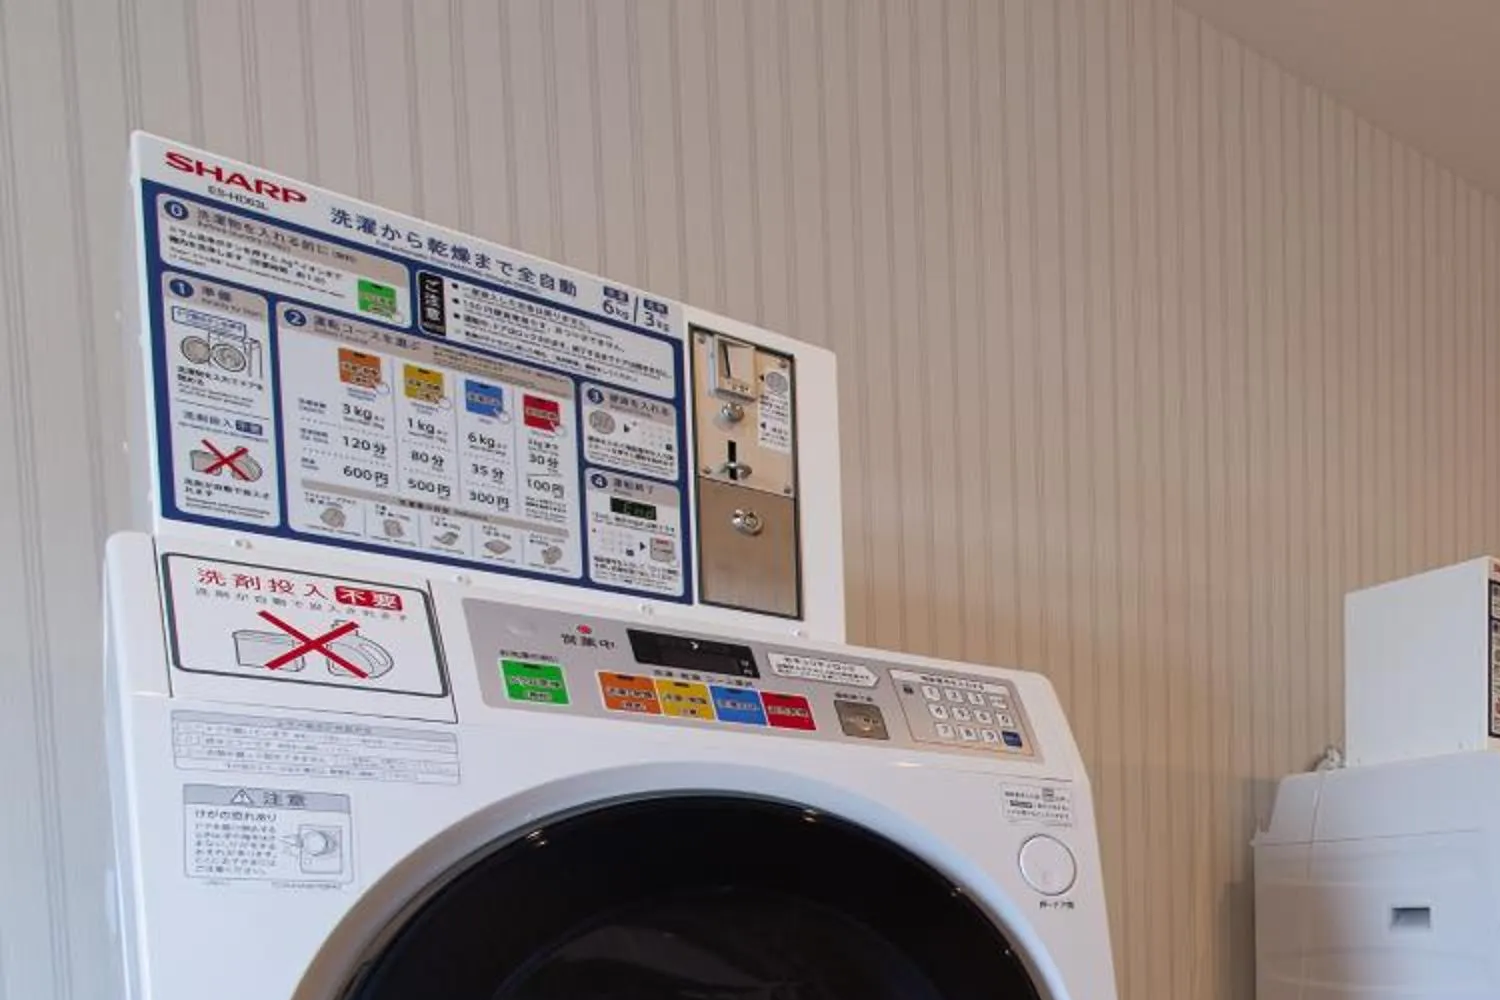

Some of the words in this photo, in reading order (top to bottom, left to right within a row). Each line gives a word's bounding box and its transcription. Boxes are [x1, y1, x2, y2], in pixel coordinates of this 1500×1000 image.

[165, 151, 307, 204] SHARP
[329, 205, 578, 298] 洗濯から乾燥まで全自動
[342, 435, 387, 456] 120分
[411, 449, 445, 468] 80分
[529, 453, 559, 469] 30分
[343, 465, 390, 486] 600円
[471, 463, 505, 480] 35分
[407, 477, 451, 498] 500円
[527, 479, 565, 499] 100円
[469, 491, 510, 510] 300円
[197, 566, 328, 600] 洗剤投入
[341, 587, 398, 610] 不要
